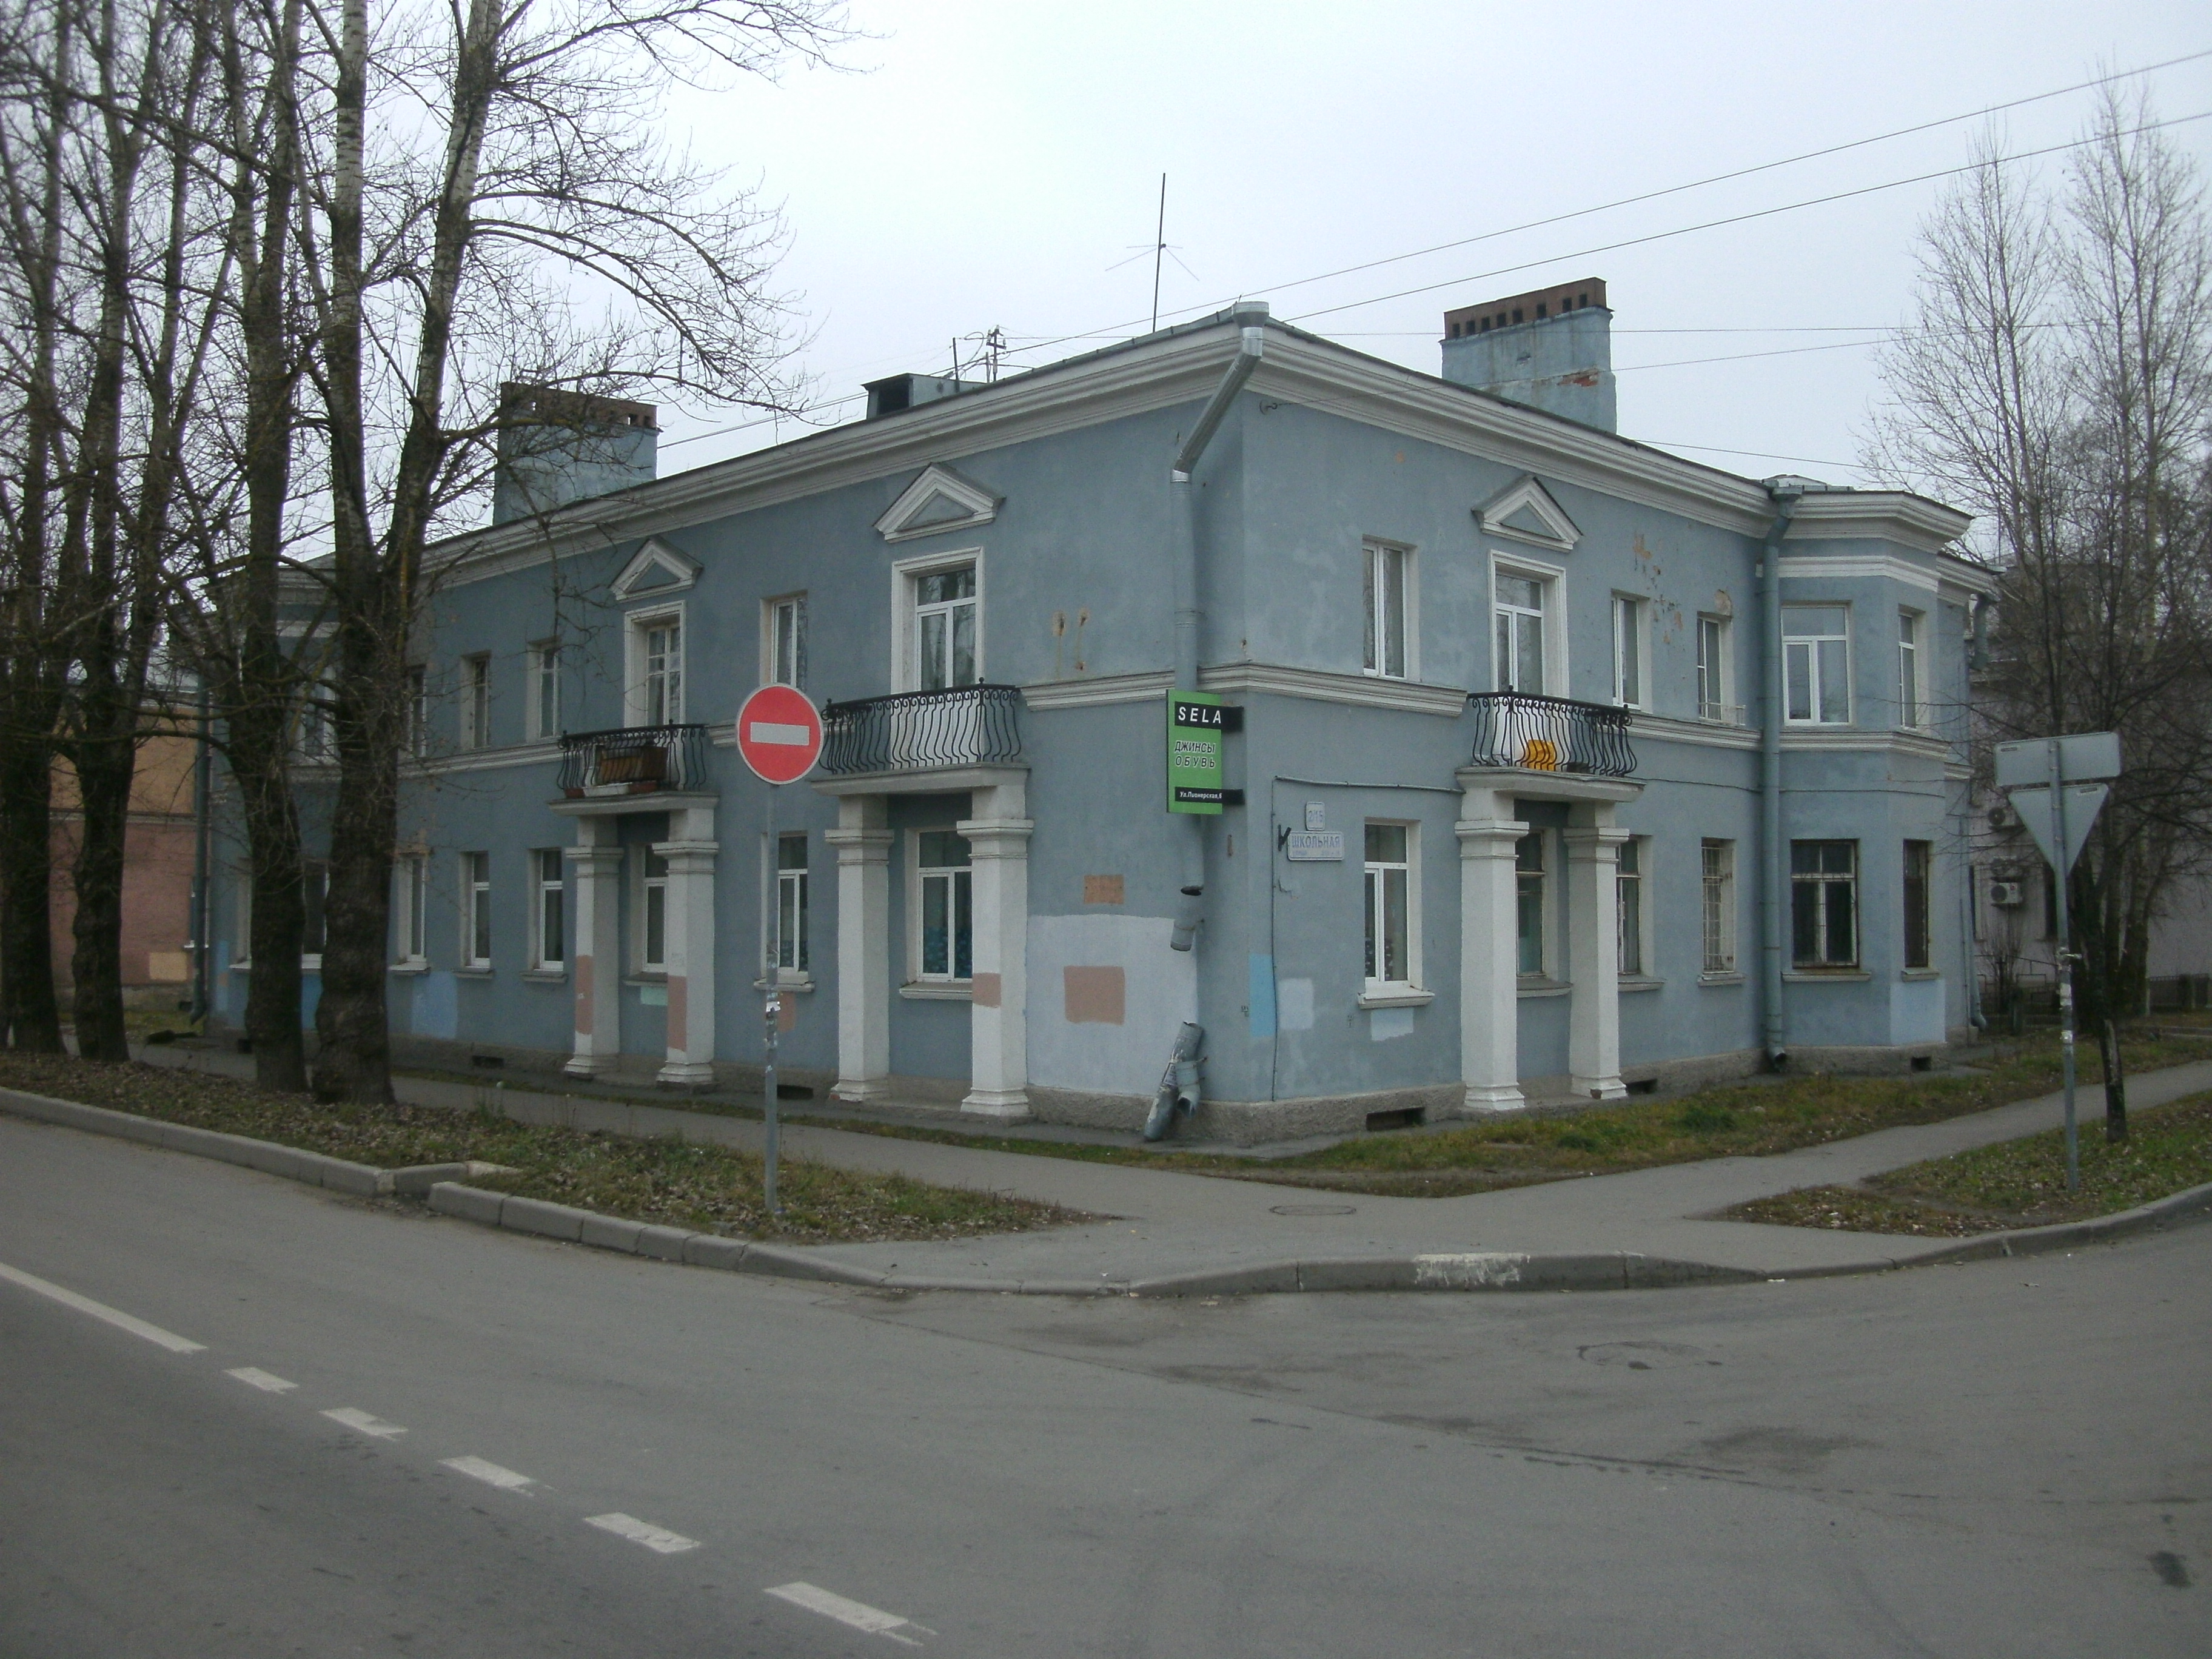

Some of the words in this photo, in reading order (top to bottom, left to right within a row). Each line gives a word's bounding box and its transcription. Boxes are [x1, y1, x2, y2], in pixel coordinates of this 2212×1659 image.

[1178, 706, 1221, 724] SELA
[1175, 740, 1215, 753] ДЖИНСЫ
[1175, 756, 1215, 768] ОБУВЬ
[1292, 836, 1340, 848] ШКОЛЬНАЯ
